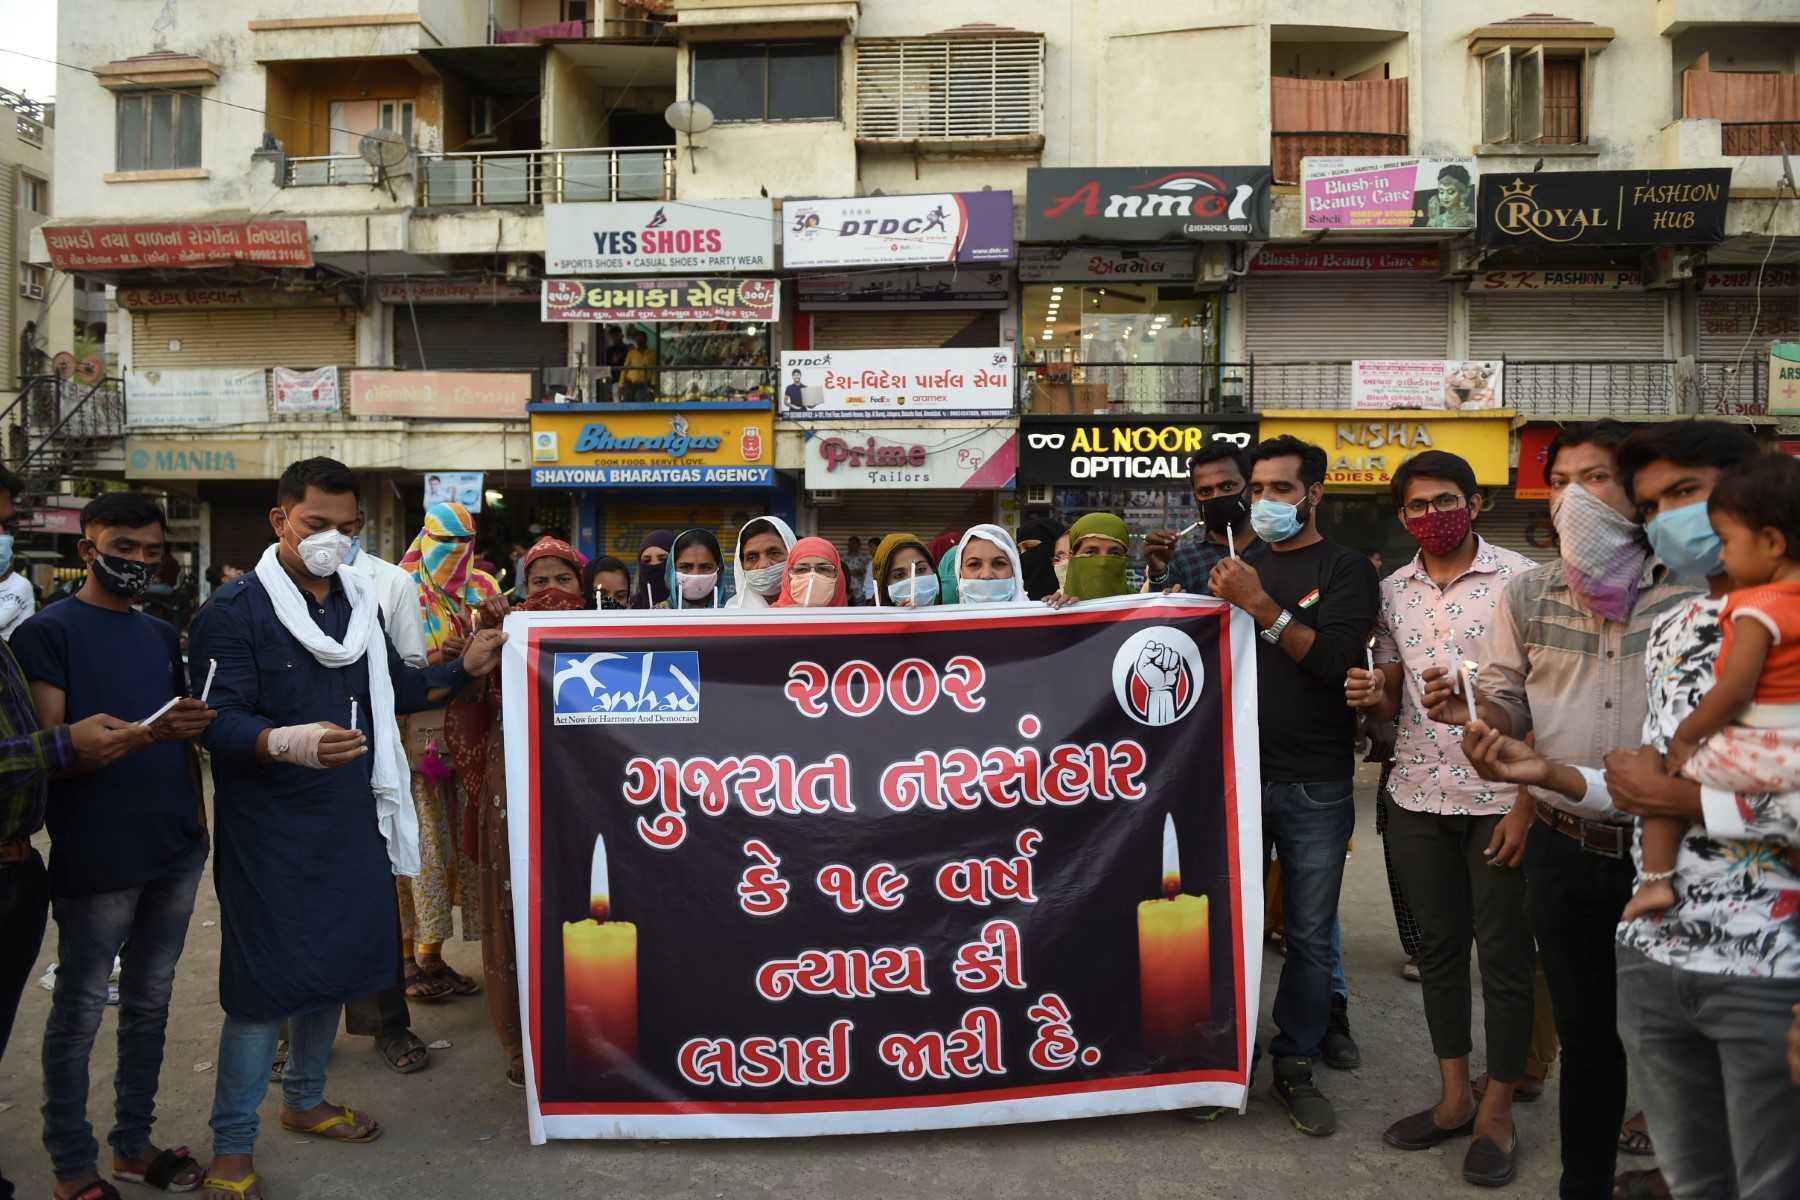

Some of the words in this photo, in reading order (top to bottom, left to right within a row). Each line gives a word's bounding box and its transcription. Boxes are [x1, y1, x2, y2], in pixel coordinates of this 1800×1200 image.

[1324, 175, 1389, 194] Blush-in
[1632, 183, 1720, 206] FASHION
[1042, 180, 1253, 221] Anmol
[1310, 194, 1366, 212] Beauty
[1372, 189, 1410, 204] Care
[839, 217, 923, 237] DTDC
[1653, 210, 1696, 230] HUB
[100, 231, 130, 249] તથા
[134, 231, 182, 247] વાળના
[593, 231, 637, 255] YES
[641, 229, 722, 255] SHOES
[561, 260, 592, 269] SPORTS
[595, 259, 623, 268] SHOES
[634, 258, 667, 267] CASUAL
[670, 257, 698, 267] SHOES
[709, 256, 736, 265] PARTY
[738, 255, 763, 265] WEAR
[1323, 254, 1374, 268] Beauty
[1544, 272, 1605, 285] FASHION
[587, 288, 678, 308] ધમાકા
[687, 281, 736, 308] સેલ
[787, 358, 823, 367] DTDC
[824, 370, 906, 390] દેશ-વિદેશ
[915, 370, 964, 389] પાર્સલ
[973, 369, 1008, 389] સેવા
[575, 422, 723, 458] Bharatgas
[1071, 426, 1109, 453] AL
[1112, 426, 1203, 453] NOOR
[1335, 422, 1433, 449] NISHA
[594, 459, 619, 467] COOK
[650, 459, 677, 467] SERVE
[818, 436, 927, 474] Prime
[1331, 456, 1387, 471] AIR
[535, 470, 606, 484] SHAYONA
[609, 469, 701, 483] BHARATGAS
[705, 468, 769, 482] AGENCY
[868, 471, 931, 485] Tailors
[1324, 472, 1374, 481] ADIES
[784, 655, 986, 718] ૨૦૦૨
[555, 715, 567, 724] Act
[569, 715, 586, 724] Now
[587, 715, 598, 723] for
[600, 714, 637, 725] Harmony
[638, 714, 654, 722] And
[655, 714, 698, 724] Democracy
[622, 752, 855, 849] ગુજરાત
[879, 713, 1146, 813] નરસંહાર
[737, 839, 791, 917] કે
[816, 860, 910, 913] ૧૯
[935, 828, 1039, 906] વર્ષ
[756, 947, 931, 1002] ન્યાય
[952, 919, 1027, 995] કી
[677, 1019, 854, 1088] લડાઈ
[879, 1005, 1006, 1082] જારી
[1027, 993, 1102, 1071] હૈ.
